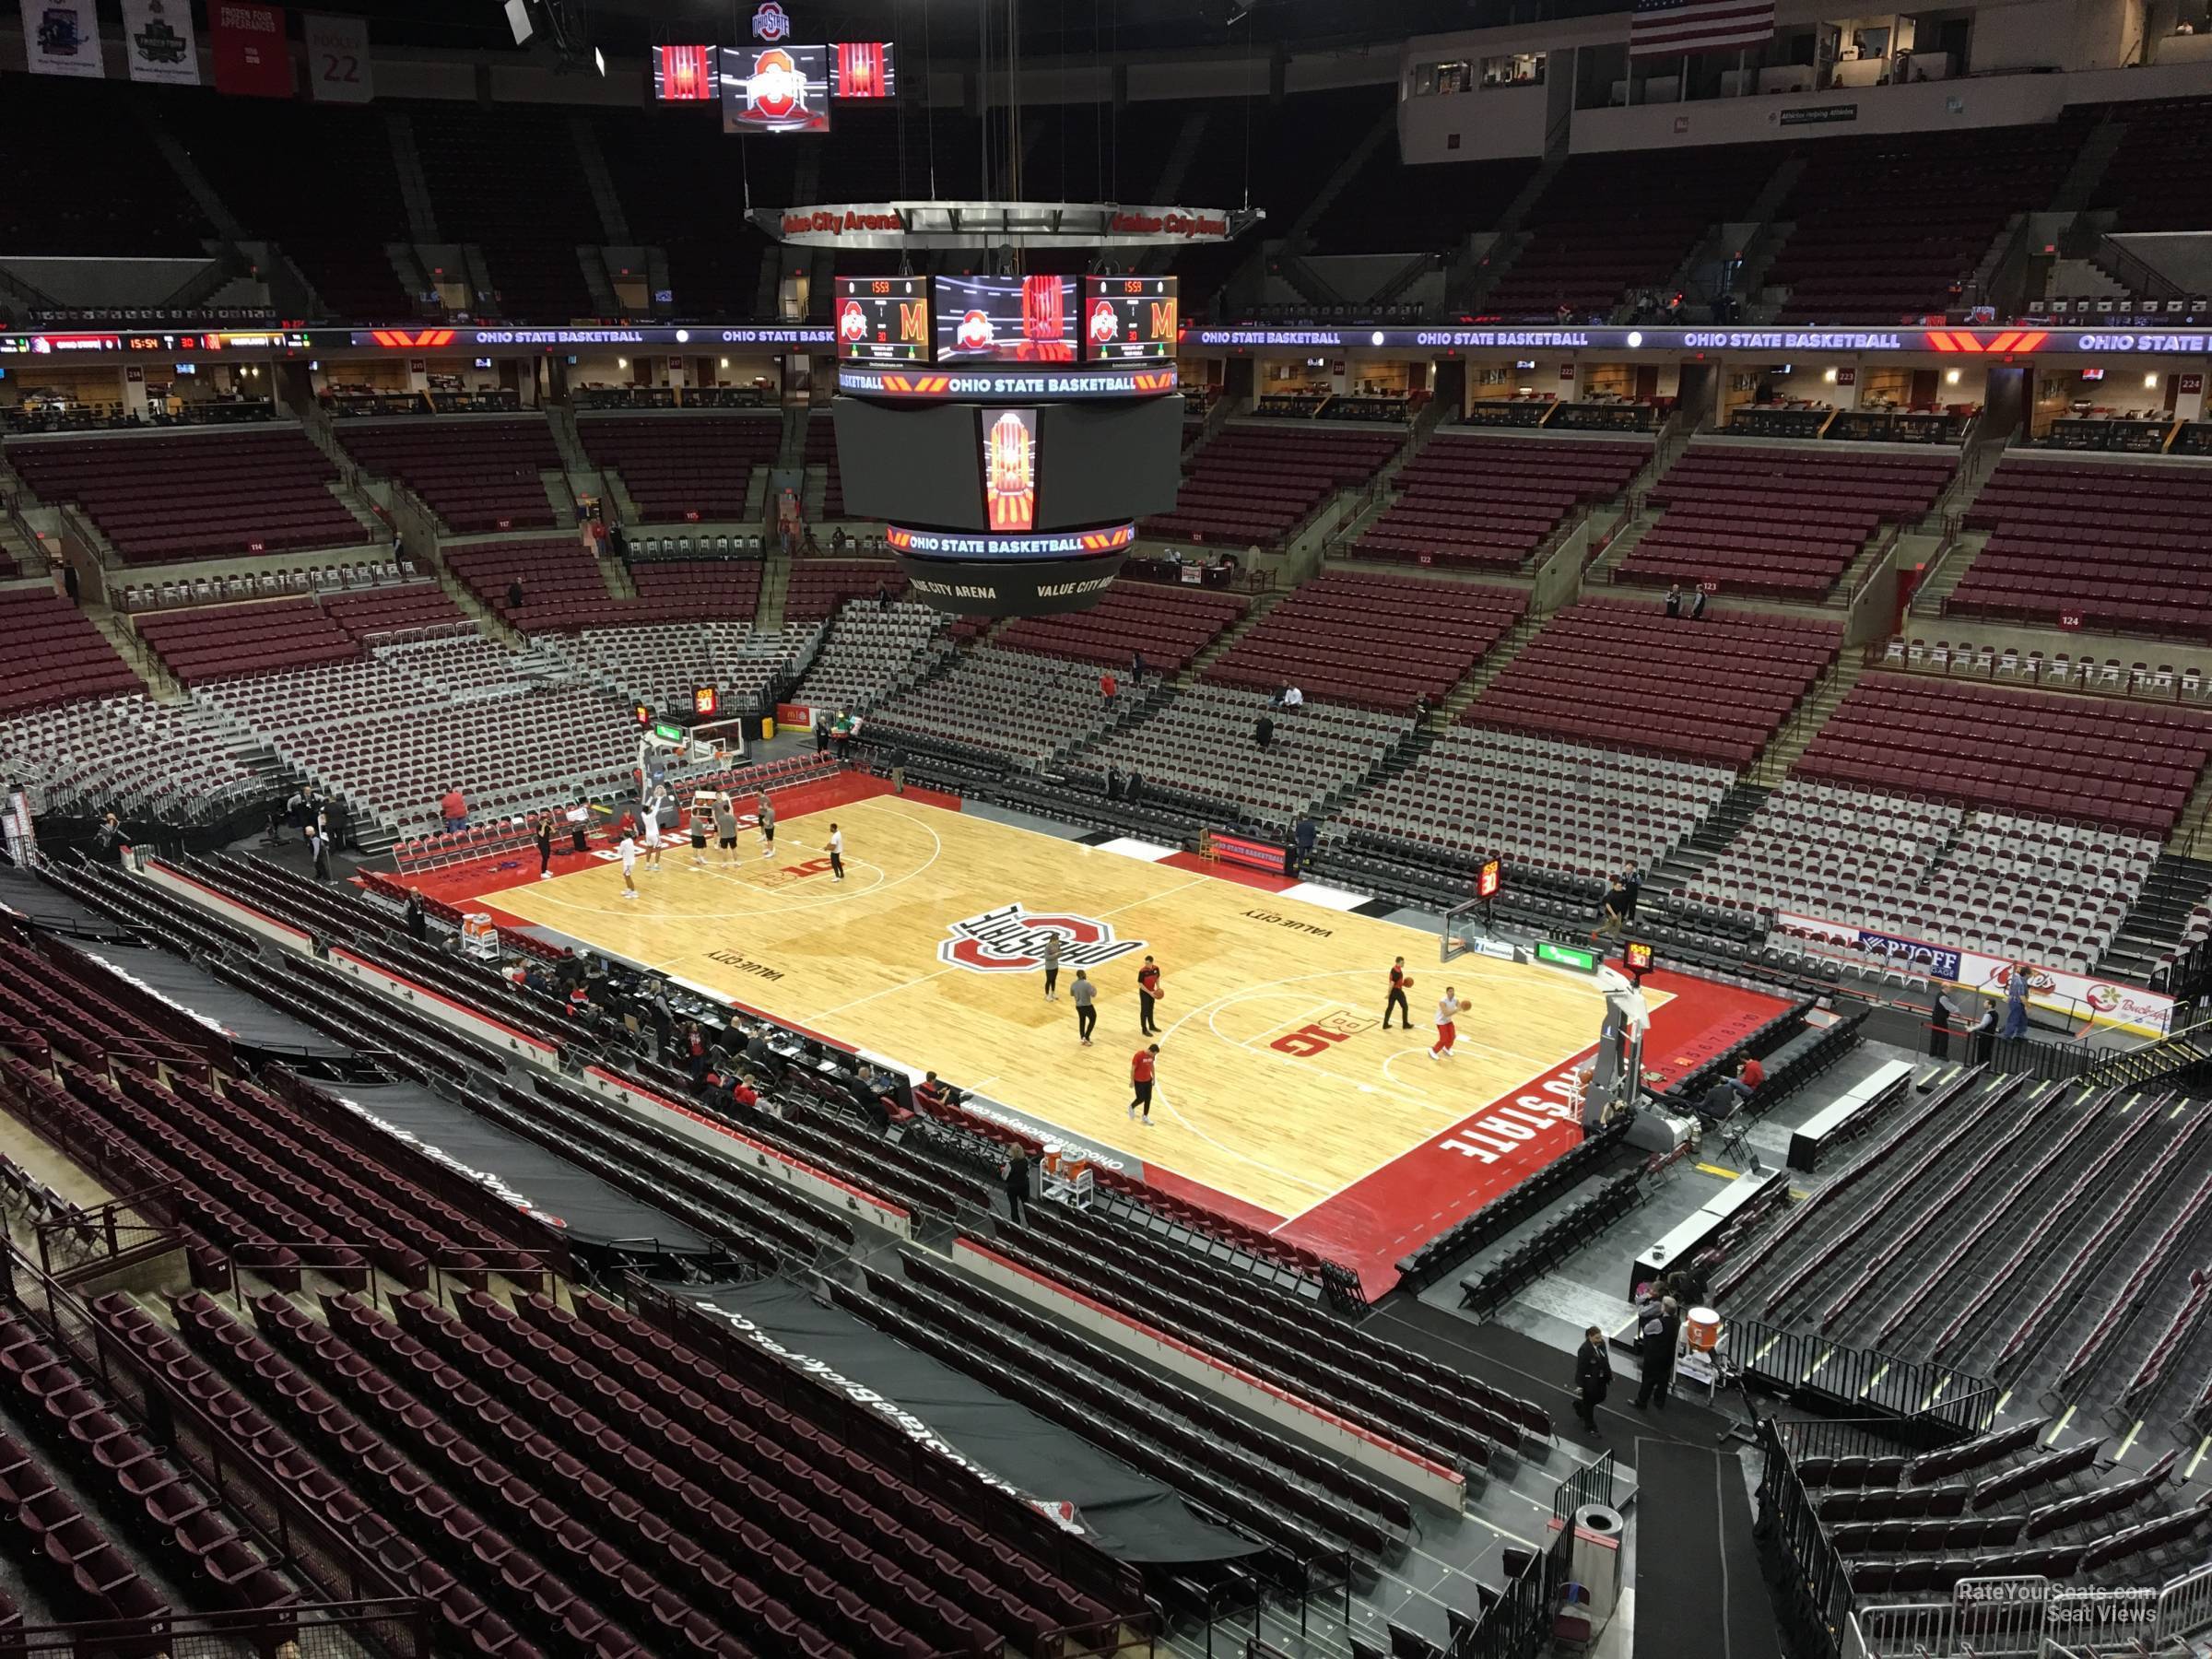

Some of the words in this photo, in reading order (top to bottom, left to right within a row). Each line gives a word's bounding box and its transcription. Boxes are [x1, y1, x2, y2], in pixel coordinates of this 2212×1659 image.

[324, 54, 359, 83] 22
[811, 212, 843, 235] City
[844, 211, 902, 230] Arena
[900, 303, 924, 341] M
[1151, 302, 1173, 338] M
[131, 339, 158, 348] 15:54
[477, 333, 512, 343] OHIO
[515, 332, 555, 343] STATE
[559, 332, 642, 342] BASKETBALL
[723, 331, 756, 342] OHIO
[759, 331, 797, 342] STATE
[1202, 333, 1230, 344] OHIO
[1231, 333, 1265, 344] STATE
[1267, 333, 1340, 345] BASKETBALL
[1418, 333, 1451, 345] OHIO
[1454, 333, 1494, 345] STATE
[1498, 333, 1588, 346] BASKETBALL
[1684, 334, 1727, 347] OHIO
[1730, 334, 1781, 347] STATE
[1785, 334, 1900, 347] BASKETBALL
[2078, 335, 2134, 350] OHIO
[2137, 335, 2202, 350] STATE
[1840, 372, 1853, 381] 223
[2183, 379, 2199, 388] 224
[948, 379, 991, 392] OHIO
[994, 378, 1044, 393] STATE
[1048, 376, 1135, 392] BASKETBALL
[910, 537, 938, 550] OHIO
[941, 539, 984, 553] STATE
[988, 538, 1084, 553] BASKETBALL
[929, 582, 951, 597] CITY
[955, 586, 996, 599] ARENA
[1038, 582, 1077, 597] VALUE
[1077, 579, 1100, 594] CITY
[2063, 617, 2079, 626] 124
[1245, 849, 1284, 863] BASKETBALL
[1240, 909, 1283, 924] CITY
[1278, 920, 1334, 938] VALUE
[702, 949, 745, 970] CITY
[1631, 954, 1646, 968] 30
[734, 960, 785, 982] VALUE
[1439, 1095, 1571, 1164] STATE
